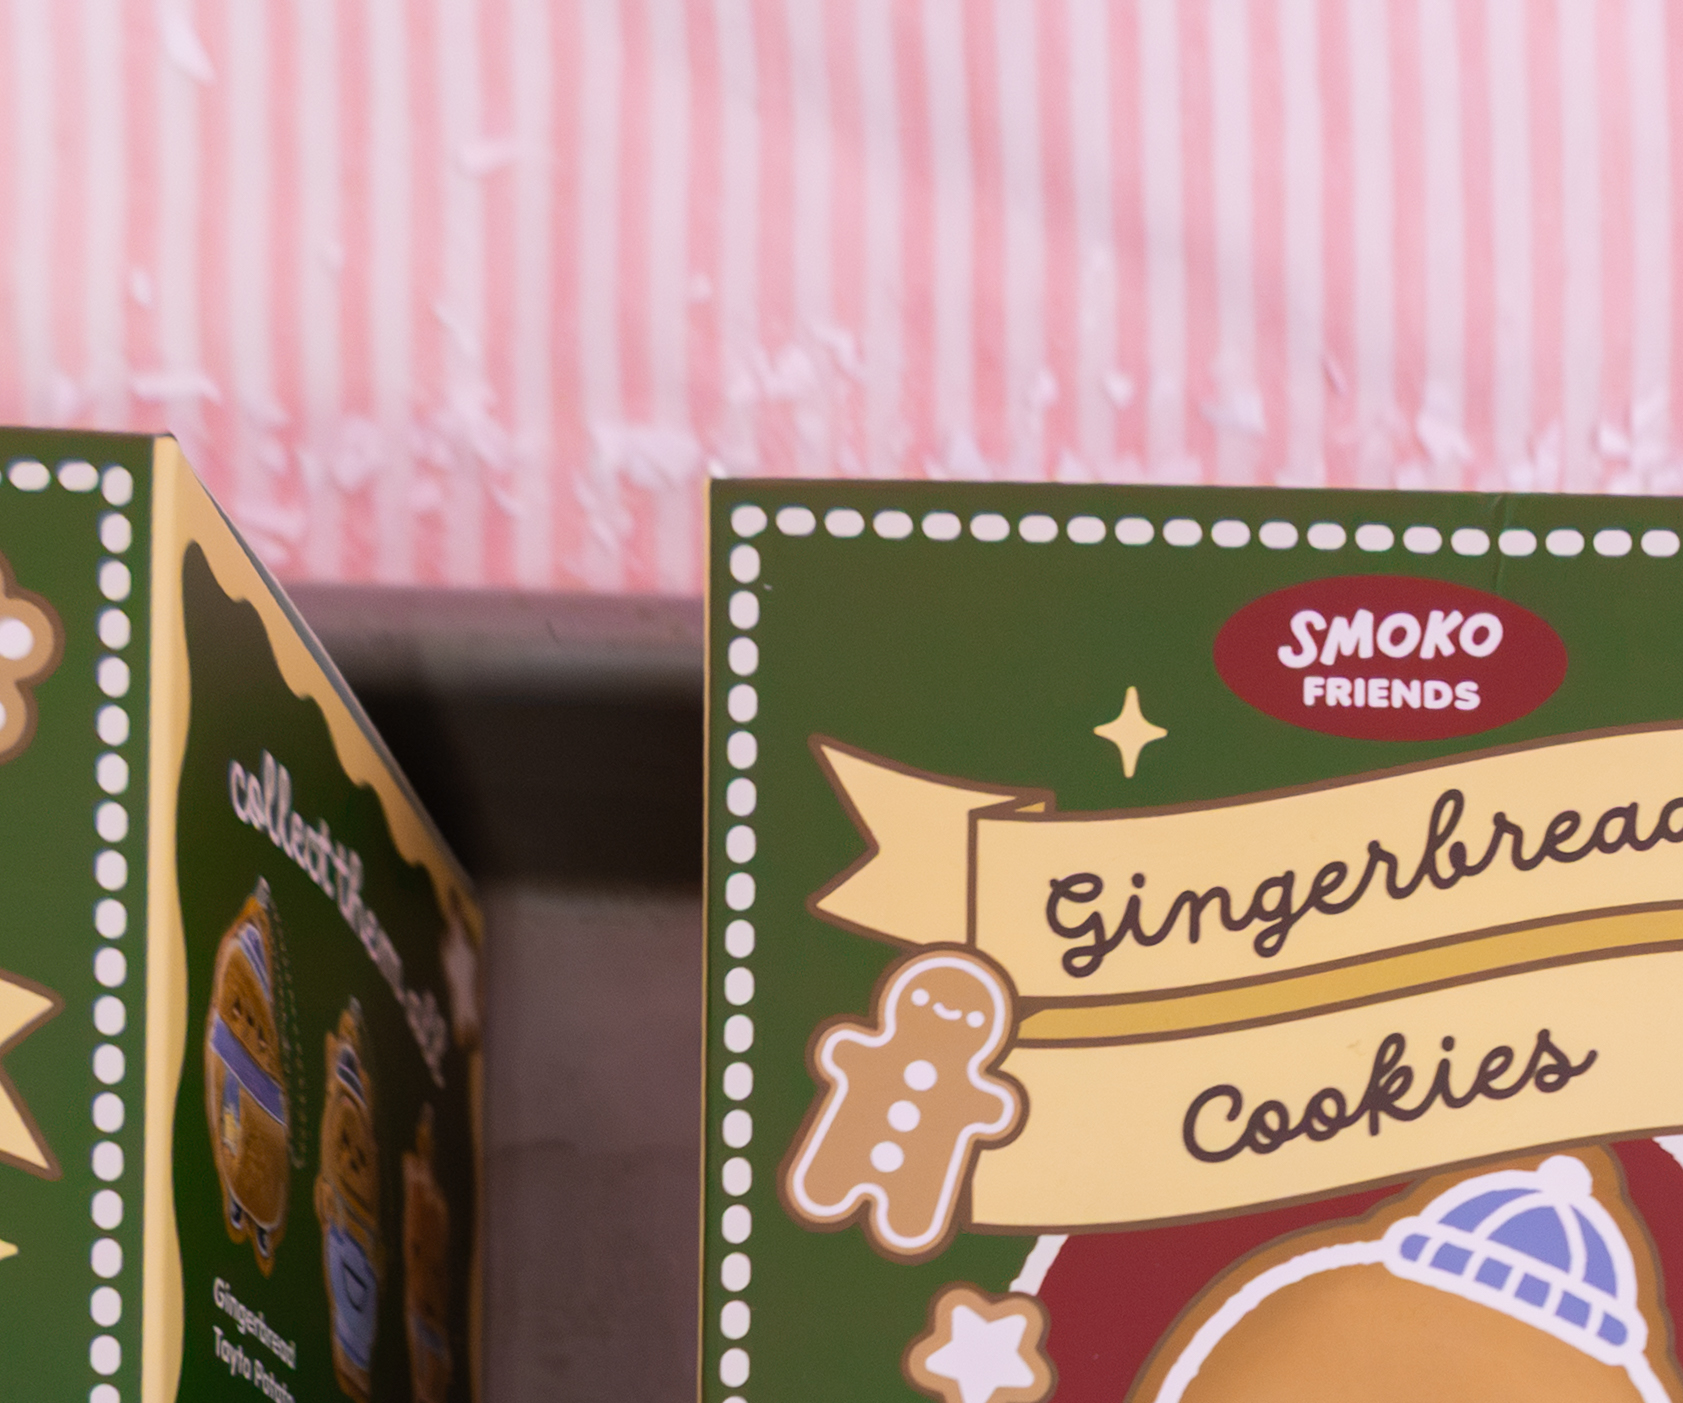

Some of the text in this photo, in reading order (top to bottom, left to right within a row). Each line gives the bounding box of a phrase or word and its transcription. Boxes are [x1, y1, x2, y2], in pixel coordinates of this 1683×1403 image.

[1277, 608, 1504, 669] SMOKO
[1302, 675, 1482, 711] FRIENDS
[1182, 1028, 1598, 1163] Cookies
